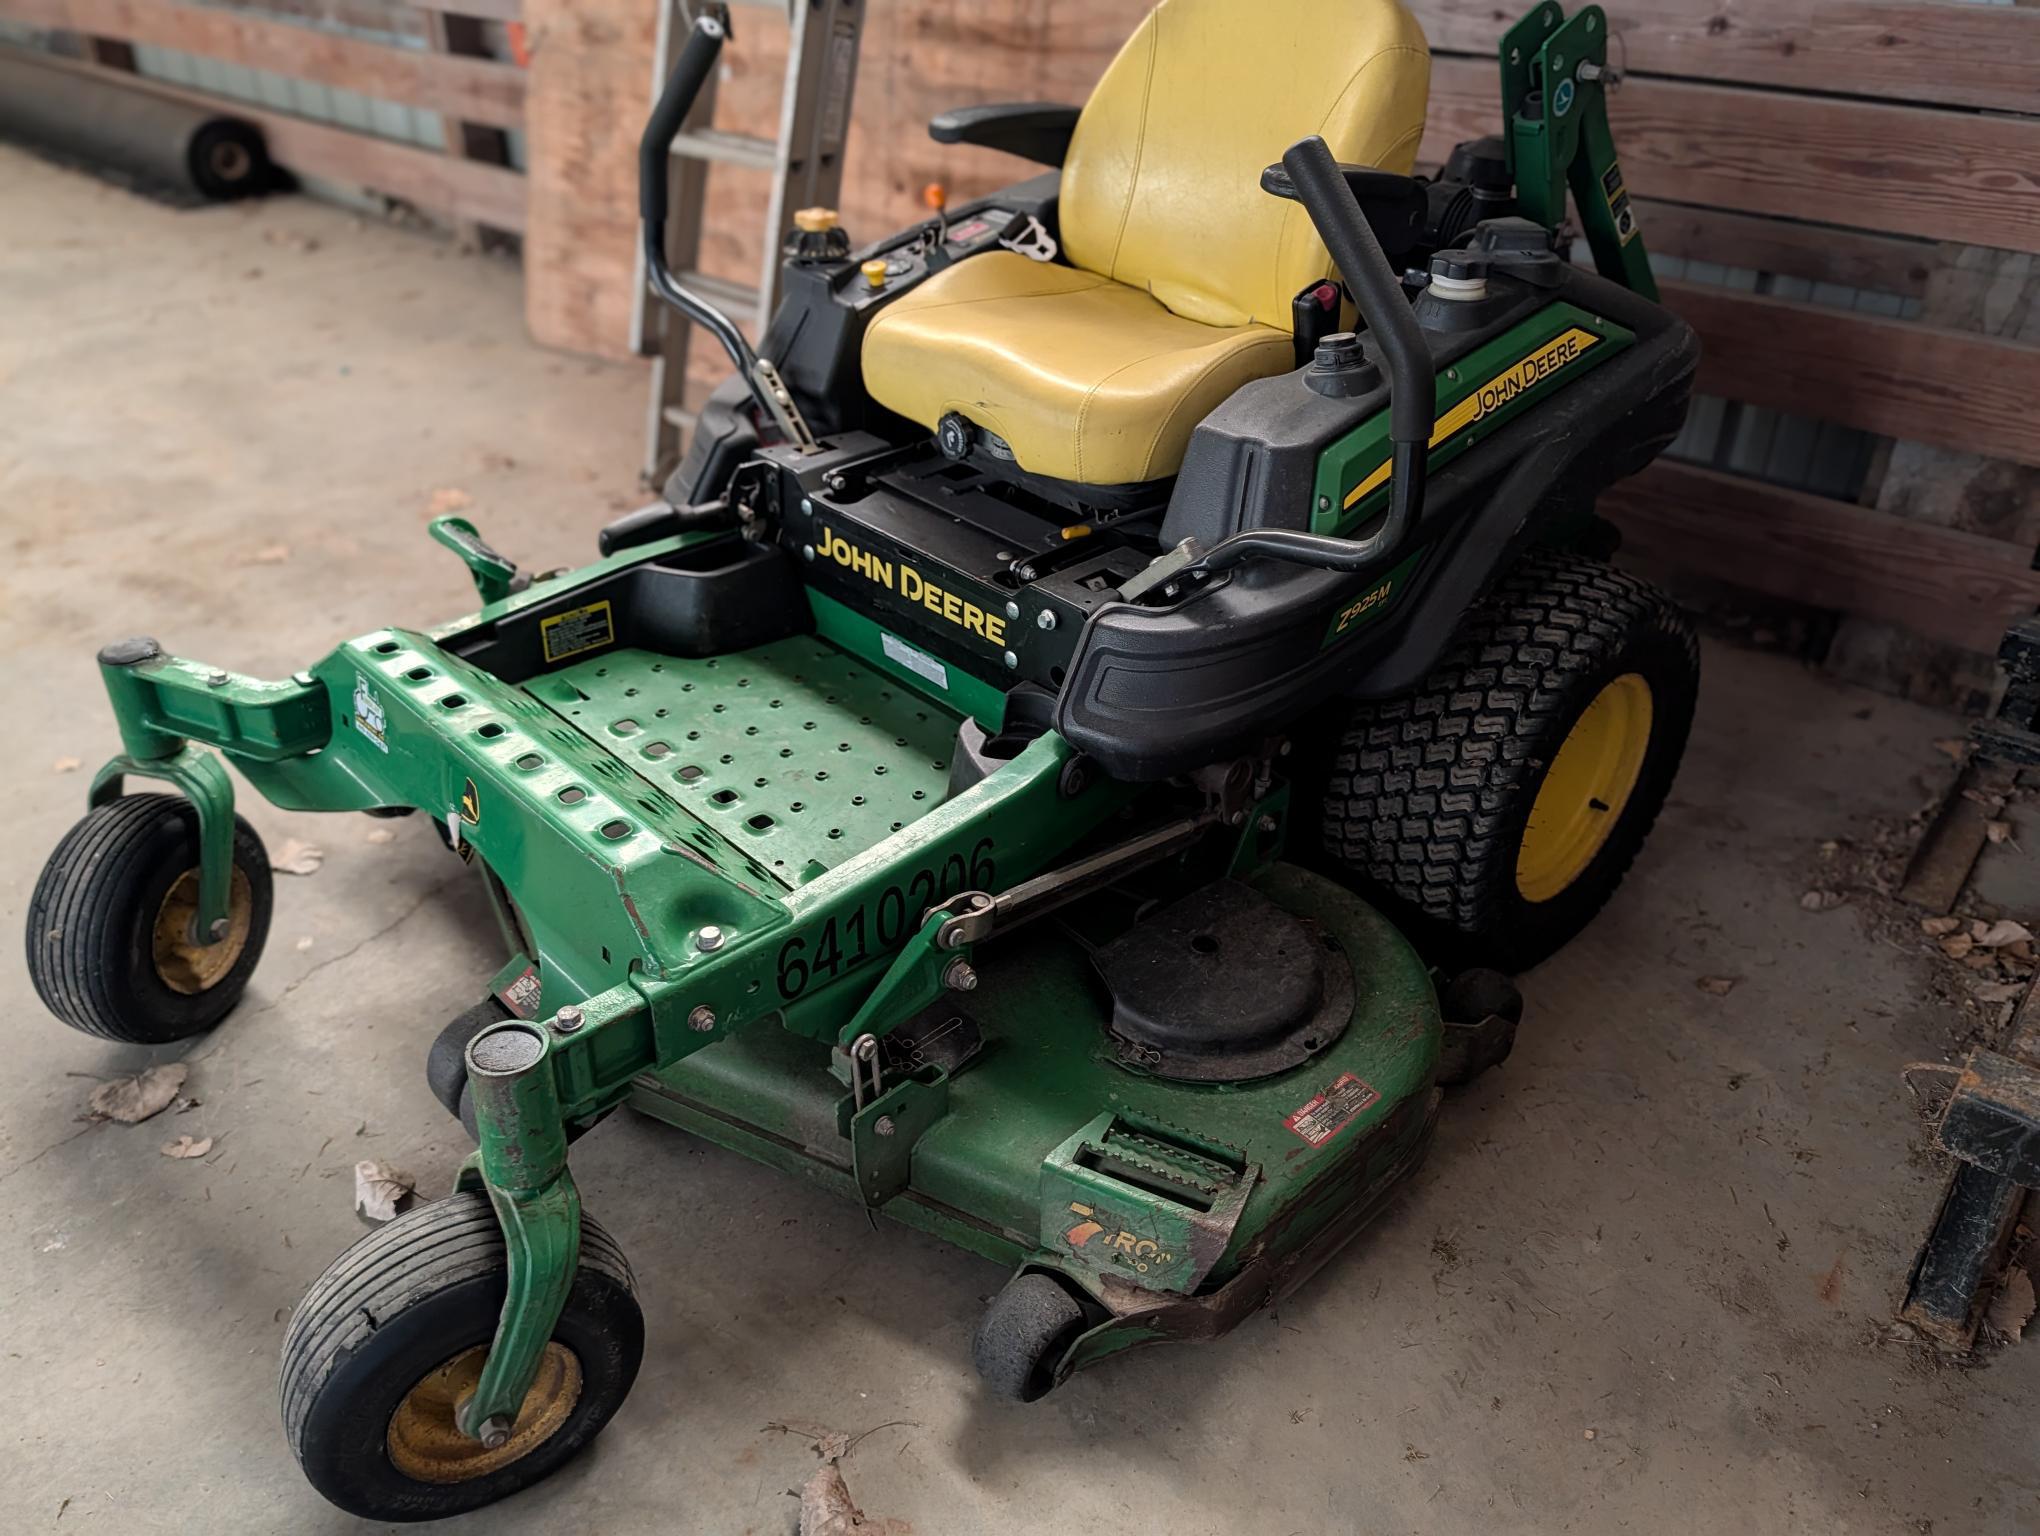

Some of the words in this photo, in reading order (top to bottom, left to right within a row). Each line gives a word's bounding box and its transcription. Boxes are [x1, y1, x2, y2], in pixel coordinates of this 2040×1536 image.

[1473, 372, 1520, 419] JOHN
[1522, 336, 1579, 385] DEERE
[817, 527, 894, 590] JOHN
[900, 564, 1006, 647] DEERE
[1336, 580, 1392, 633] Z925M
